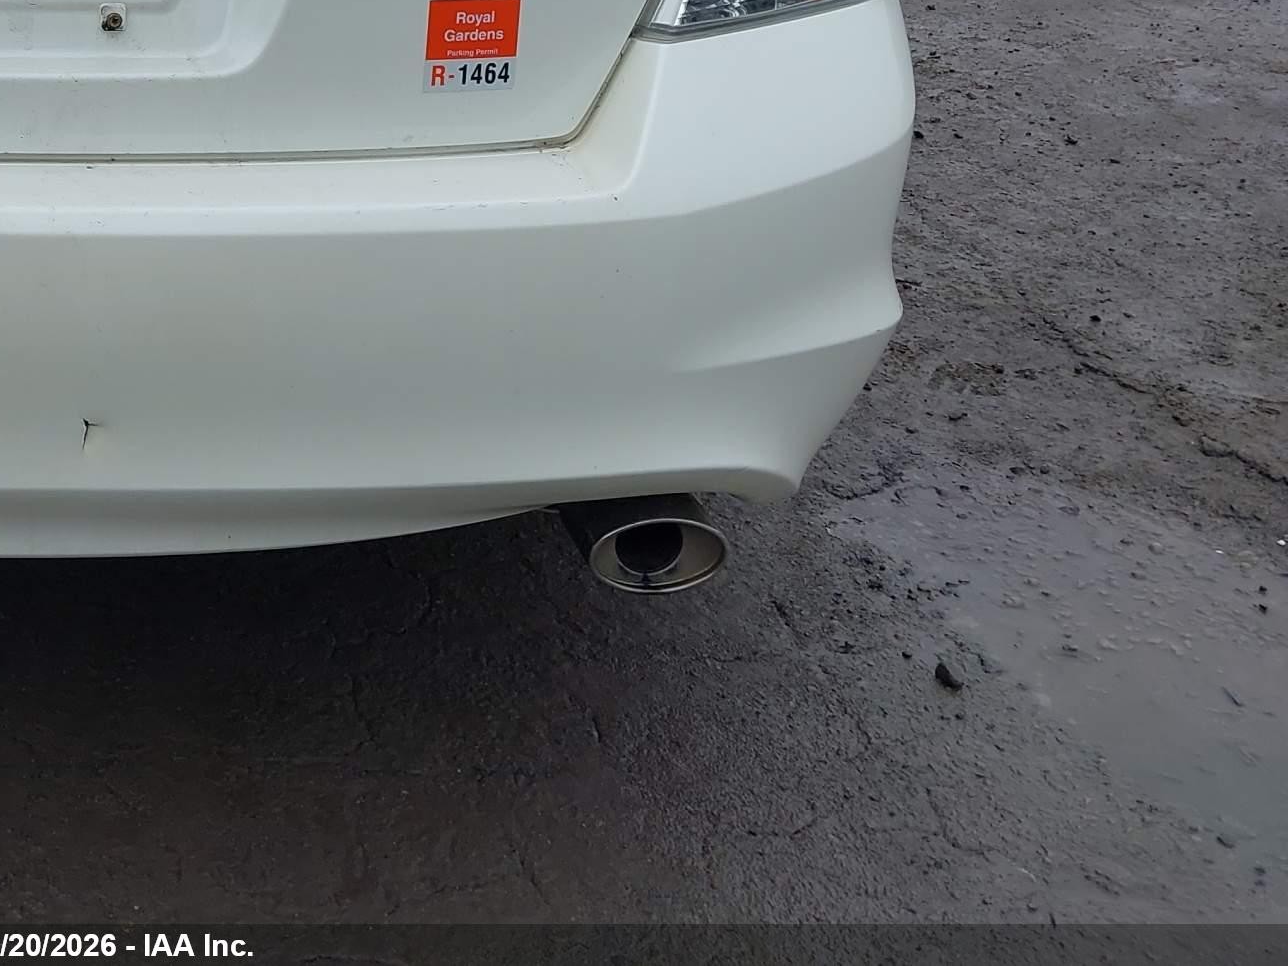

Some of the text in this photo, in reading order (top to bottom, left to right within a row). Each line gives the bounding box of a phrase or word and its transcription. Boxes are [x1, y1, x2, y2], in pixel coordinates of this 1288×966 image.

[455, 10, 496, 27] Royal
[443, 28, 505, 43] Gardens
[446, 47, 499, 58] Parking Permit
